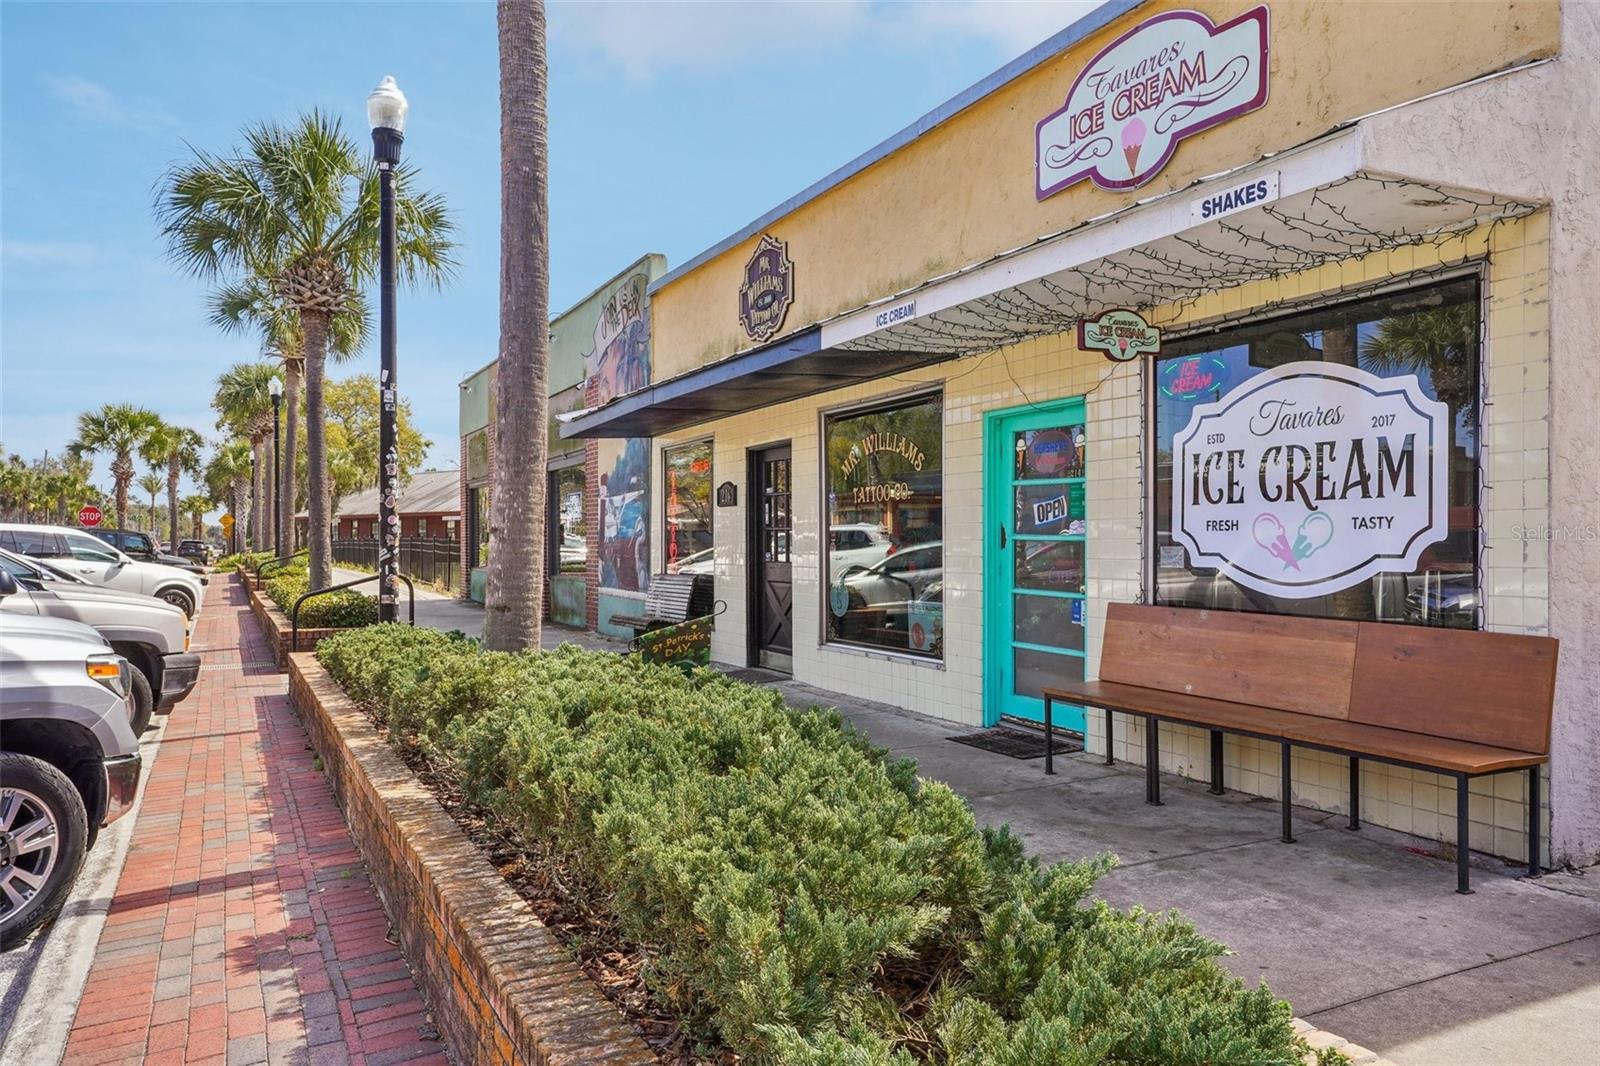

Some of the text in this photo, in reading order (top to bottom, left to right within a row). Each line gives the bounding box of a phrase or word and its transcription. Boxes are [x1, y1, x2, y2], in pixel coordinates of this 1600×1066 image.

[1086, 41, 1184, 100] Tavares
[1069, 50, 1207, 145] ICE CREAM
[1201, 179, 1268, 219] SHAKES
[747, 275, 783, 308] WILLIAMS
[876, 303, 914, 327] ICE CREAM
[1104, 314, 1139, 327] Tavares
[1098, 324, 1147, 340] ICE CREAM
[1180, 360, 1200, 376] ICE
[1171, 373, 1214, 393] CREAM
[1249, 399, 1345, 436] Tavares
[1371, 414, 1396, 428] 2017
[1207, 433, 1225, 445] ESTD
[862, 432, 926, 471] WILLIAMS
[1191, 433, 1417, 511] ICE CREAM
[853, 484, 891, 504] TATTOO
[80, 512, 101, 521] STOP
[1036, 498, 1065, 523] OPEN
[1206, 519, 1239, 532] FRESH
[1352, 516, 1394, 531] TASTY
[665, 642, 691, 657] DAY
[666, 632, 705, 647] Patrick's
